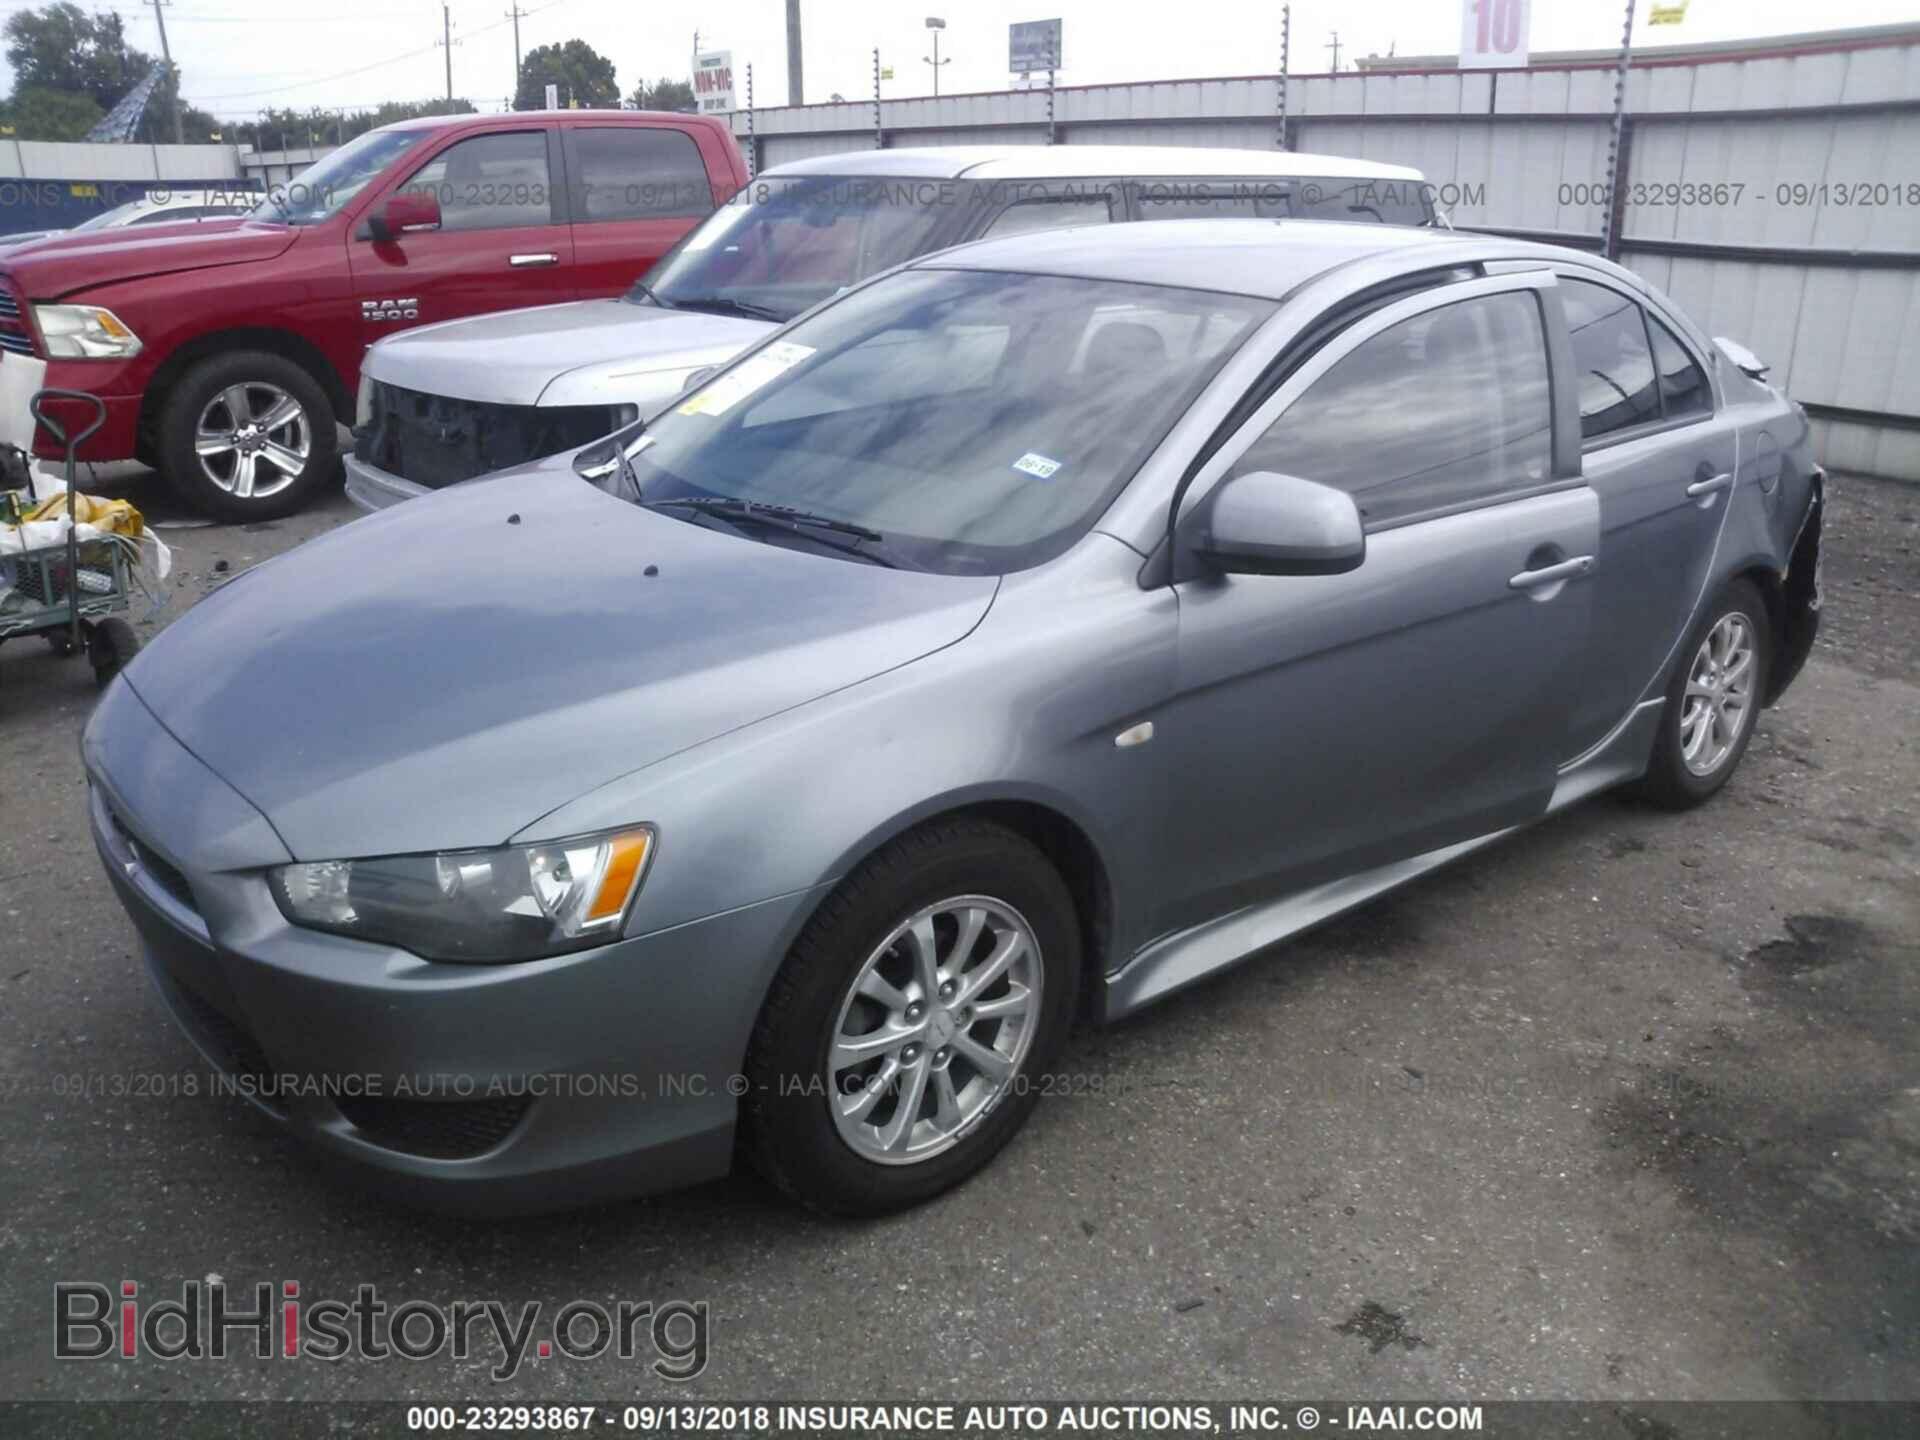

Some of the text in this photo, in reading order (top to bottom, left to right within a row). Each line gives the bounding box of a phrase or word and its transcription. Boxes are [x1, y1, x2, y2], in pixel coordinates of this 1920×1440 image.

[1473, 0, 1521, 54] 10
[362, 298, 418, 310] RAM
[363, 309, 418, 321] 1500
